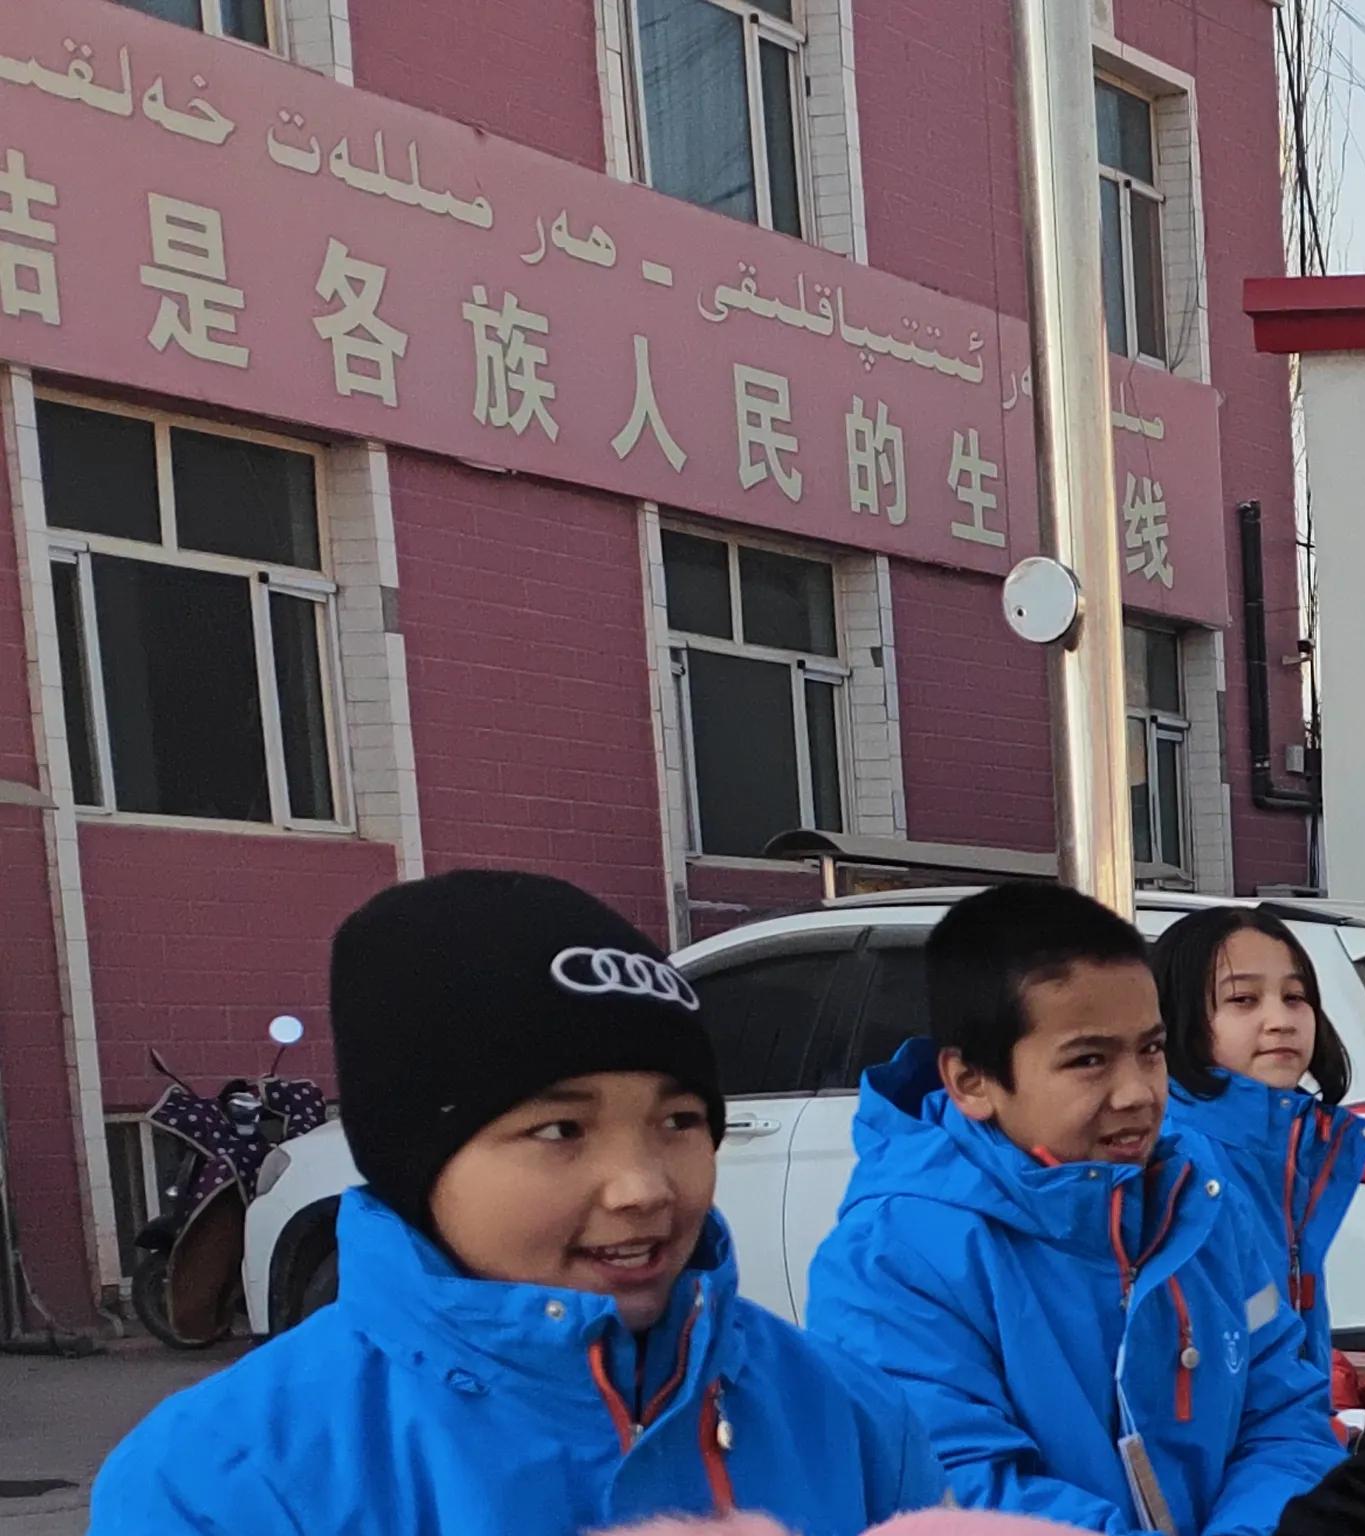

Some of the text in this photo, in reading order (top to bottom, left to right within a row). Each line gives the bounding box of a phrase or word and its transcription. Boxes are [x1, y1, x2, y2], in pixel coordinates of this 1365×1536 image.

[0, 148, 1173, 589] 是各族人民的生线
